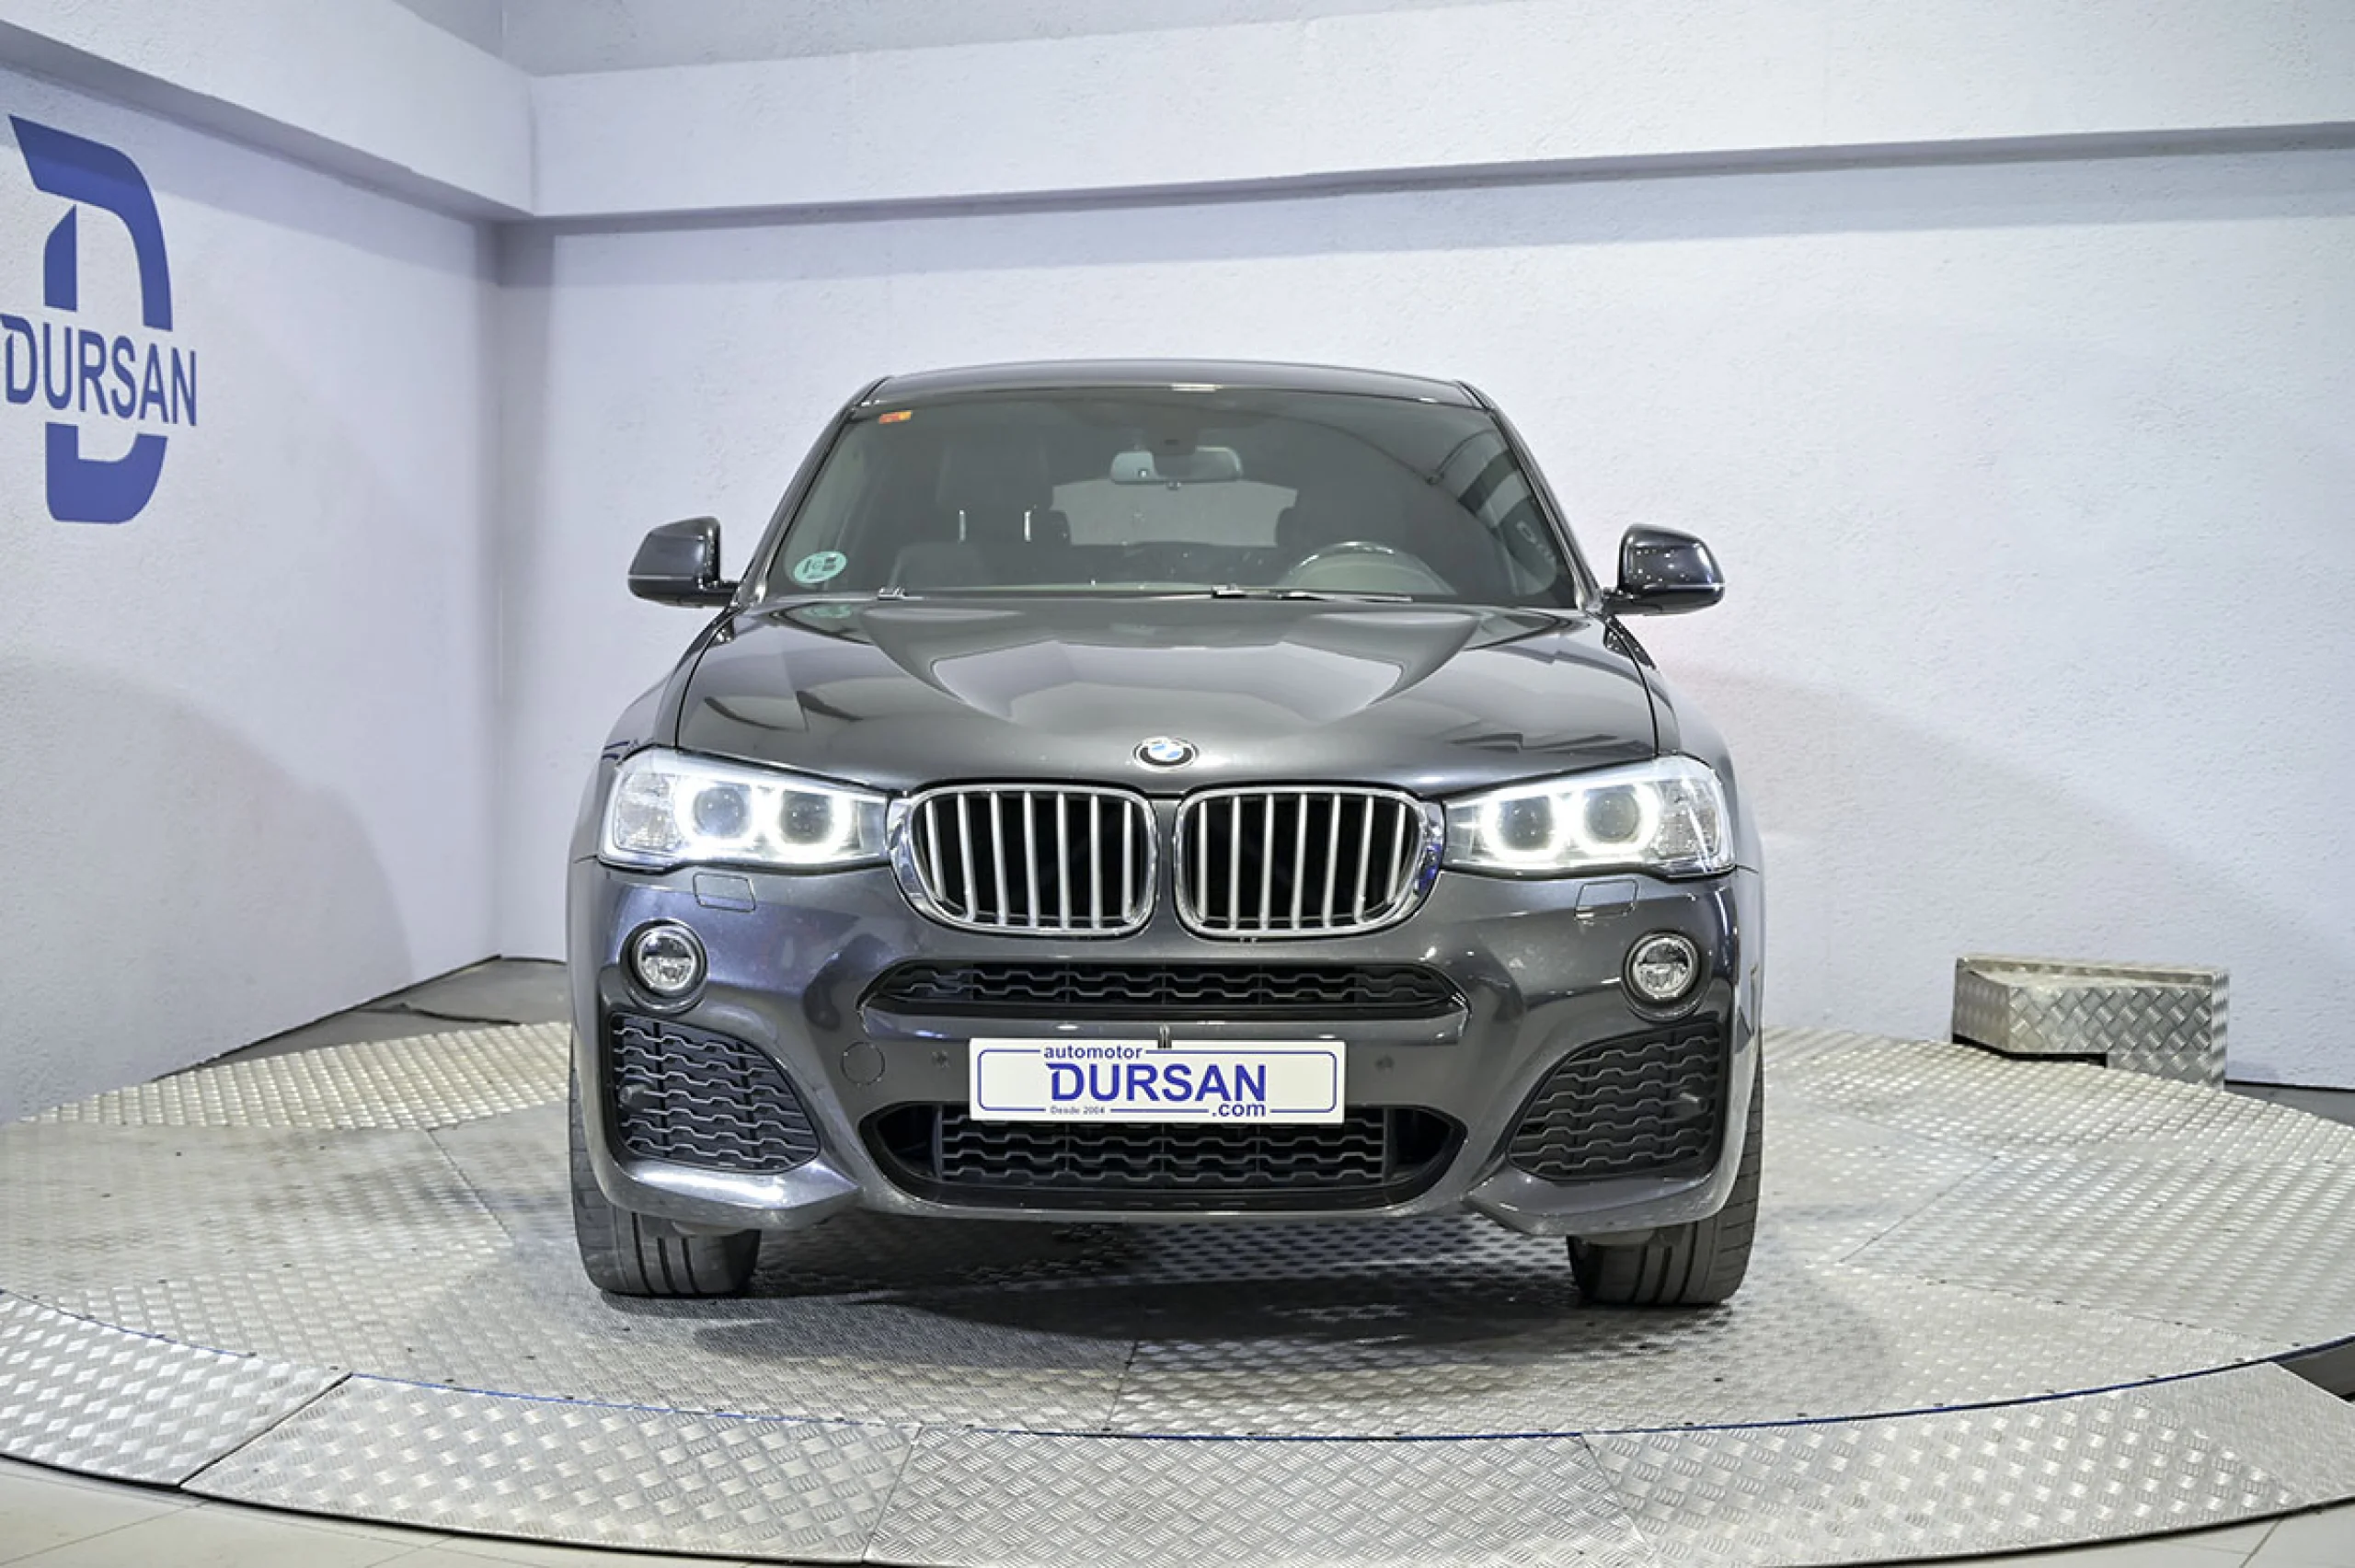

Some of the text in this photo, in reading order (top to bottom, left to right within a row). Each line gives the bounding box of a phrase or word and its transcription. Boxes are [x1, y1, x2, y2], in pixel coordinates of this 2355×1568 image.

[0, 313, 197, 427] DURSAN
[1043, 1045, 1143, 1059] automotor
[1046, 1062, 1266, 1102] DURSAN
[1050, 1105, 1080, 1115] Desde
[1212, 1104, 1267, 1116] .com
